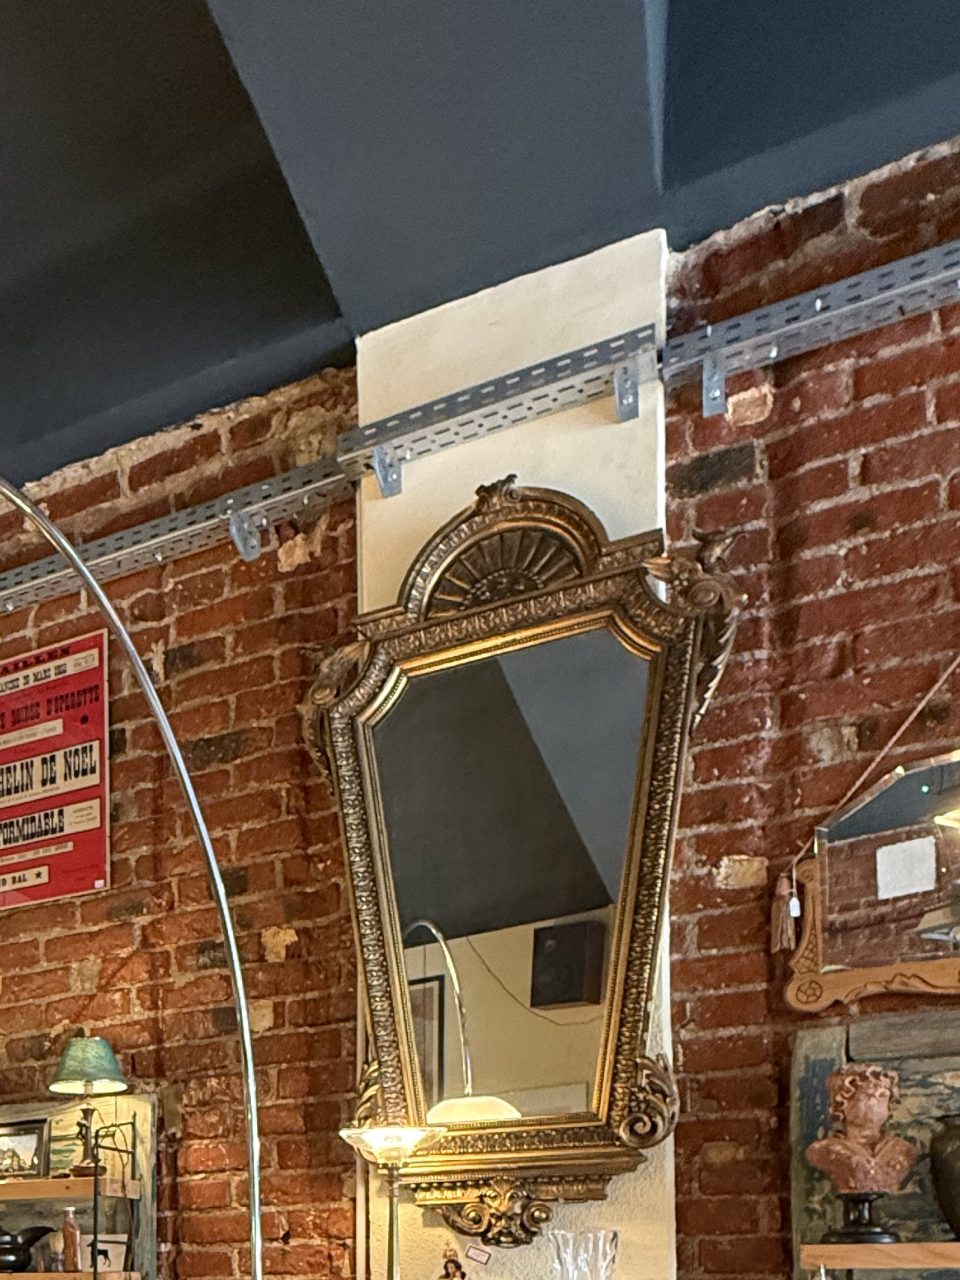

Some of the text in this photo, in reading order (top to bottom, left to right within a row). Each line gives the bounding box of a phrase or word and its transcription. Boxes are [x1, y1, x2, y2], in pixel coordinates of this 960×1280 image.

[41, 754, 57, 787] DE
[63, 743, 97, 782] NOEL
[11, 872, 28, 886] BAL
